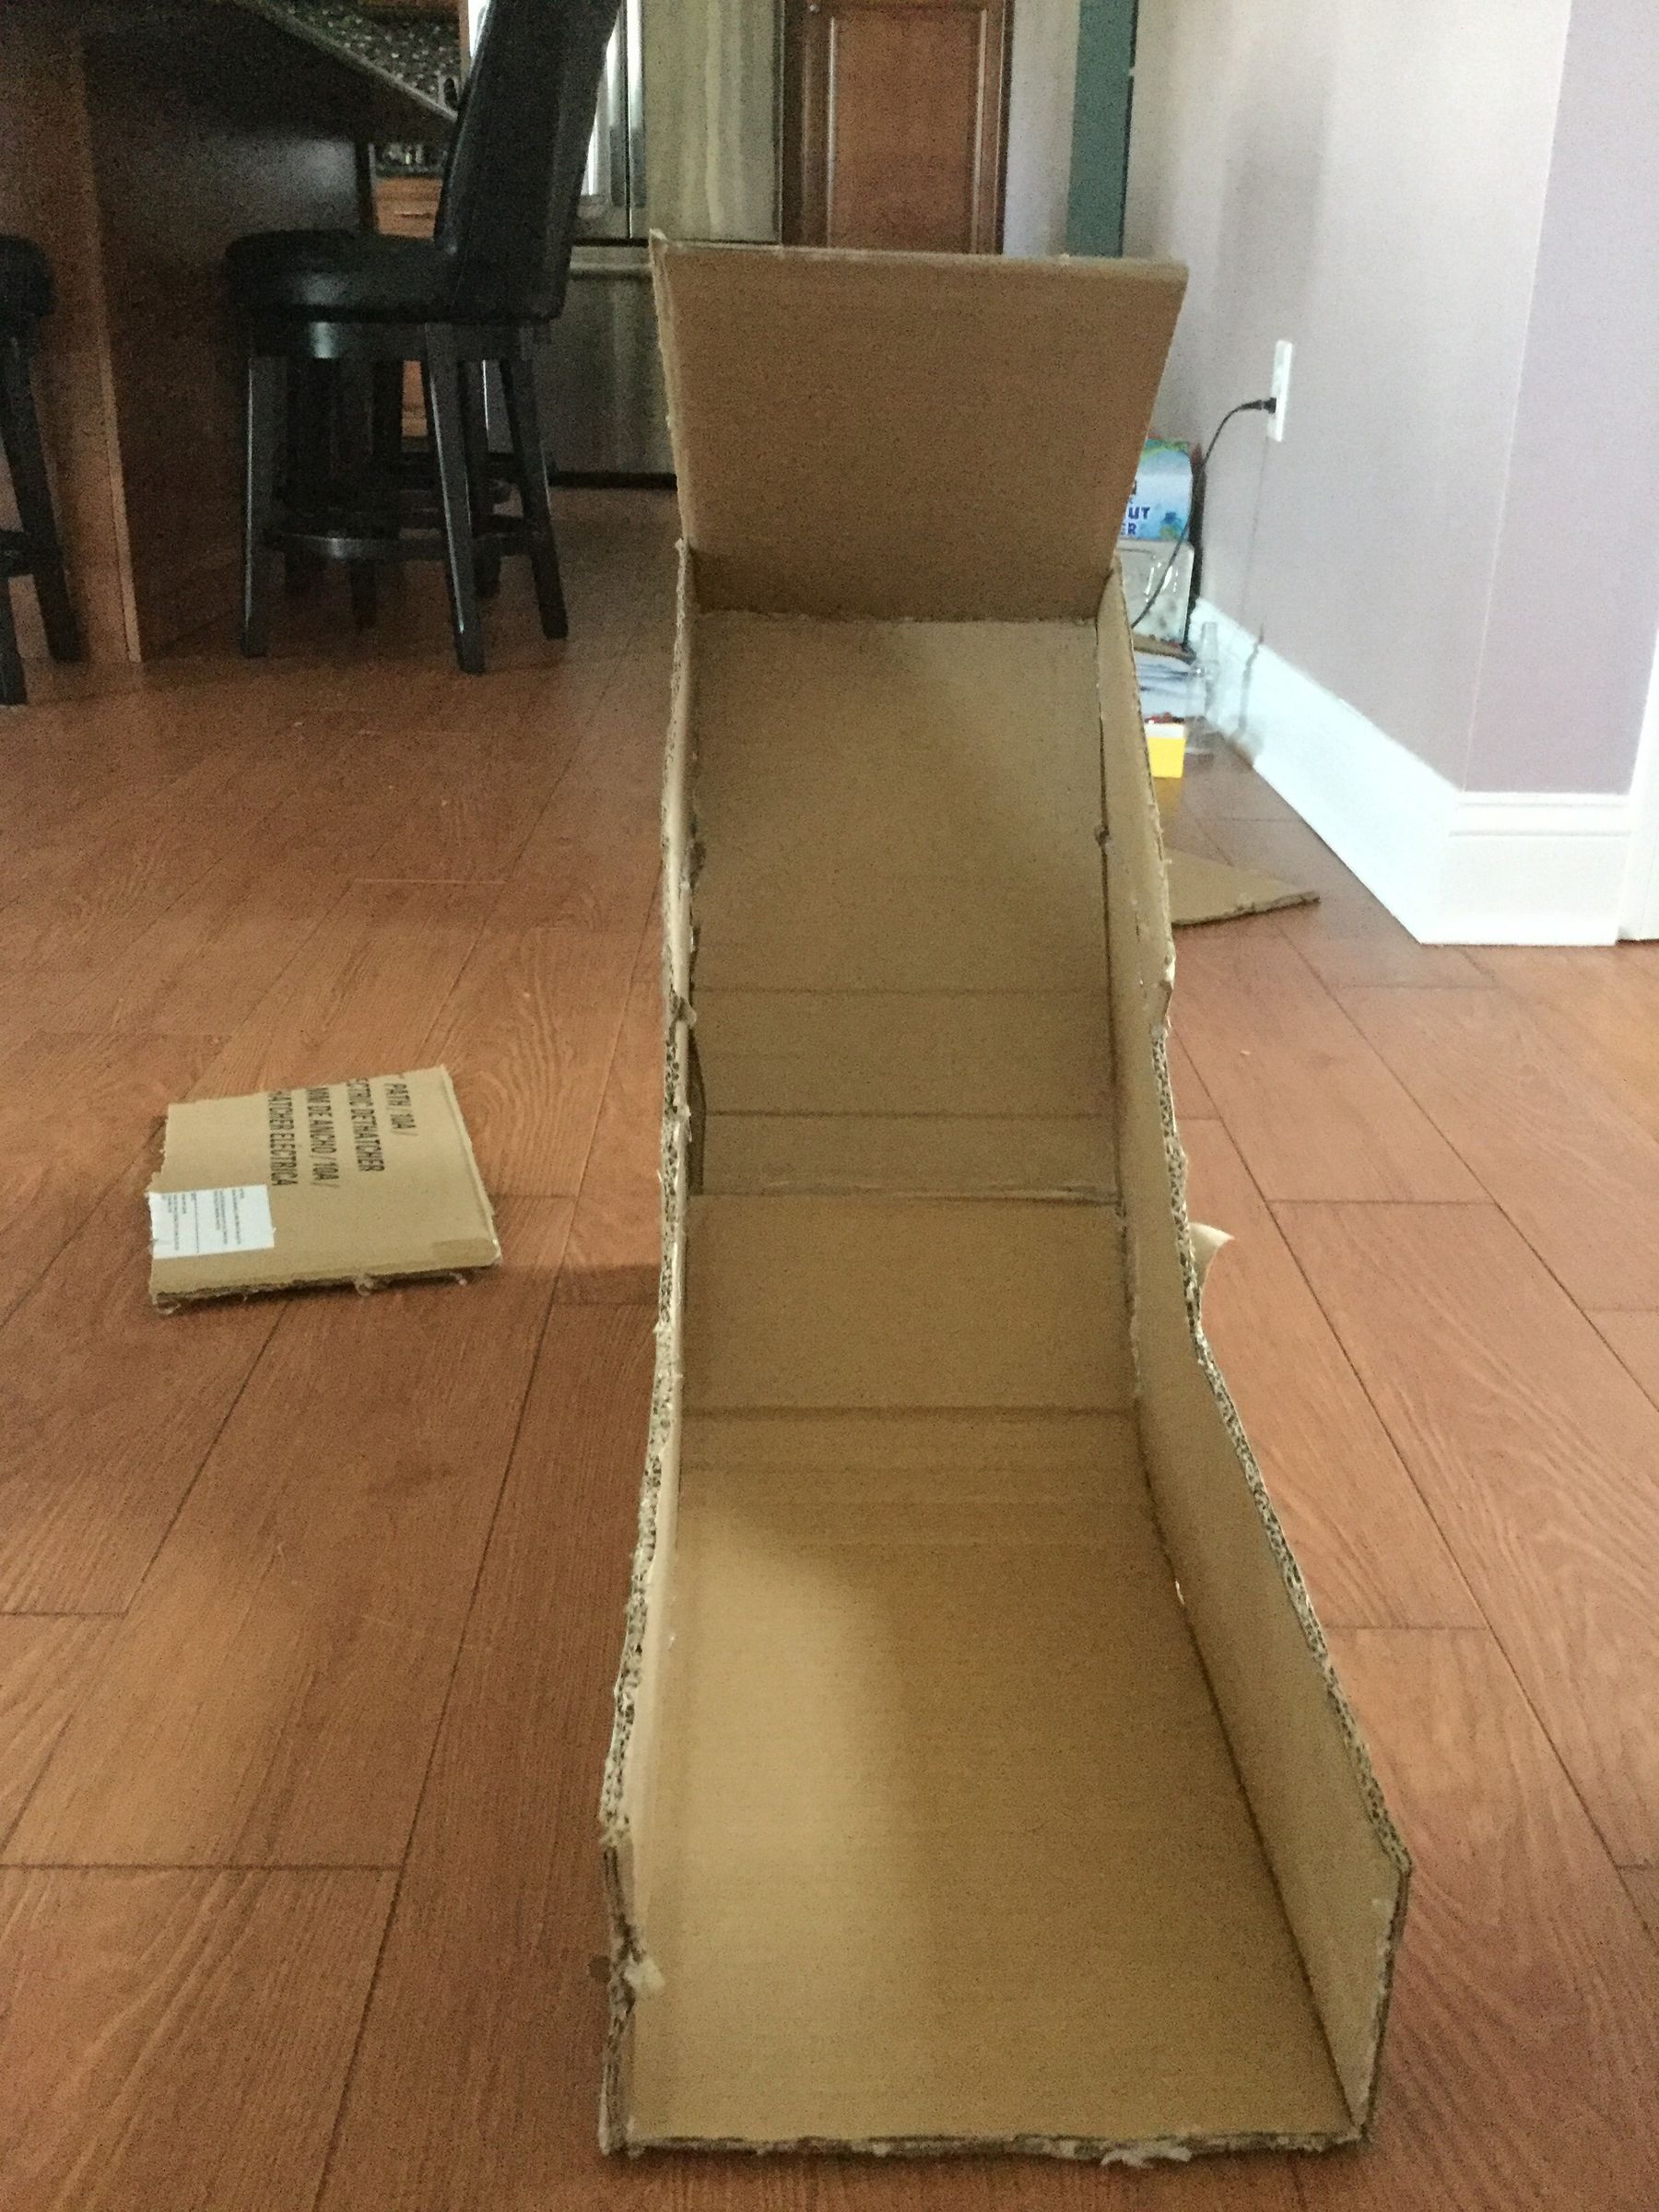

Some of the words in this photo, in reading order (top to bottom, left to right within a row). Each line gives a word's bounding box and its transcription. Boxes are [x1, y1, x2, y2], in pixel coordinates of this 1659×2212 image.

[383, 1083, 412, 1107] PATH
[307, 1105, 333, 1118] DE
[390, 1113, 417, 1130] 10A
[309, 1120, 337, 1153] ANCHO
[350, 1109, 385, 1171] DETHATCHER
[312, 1162, 340, 1181] 10A
